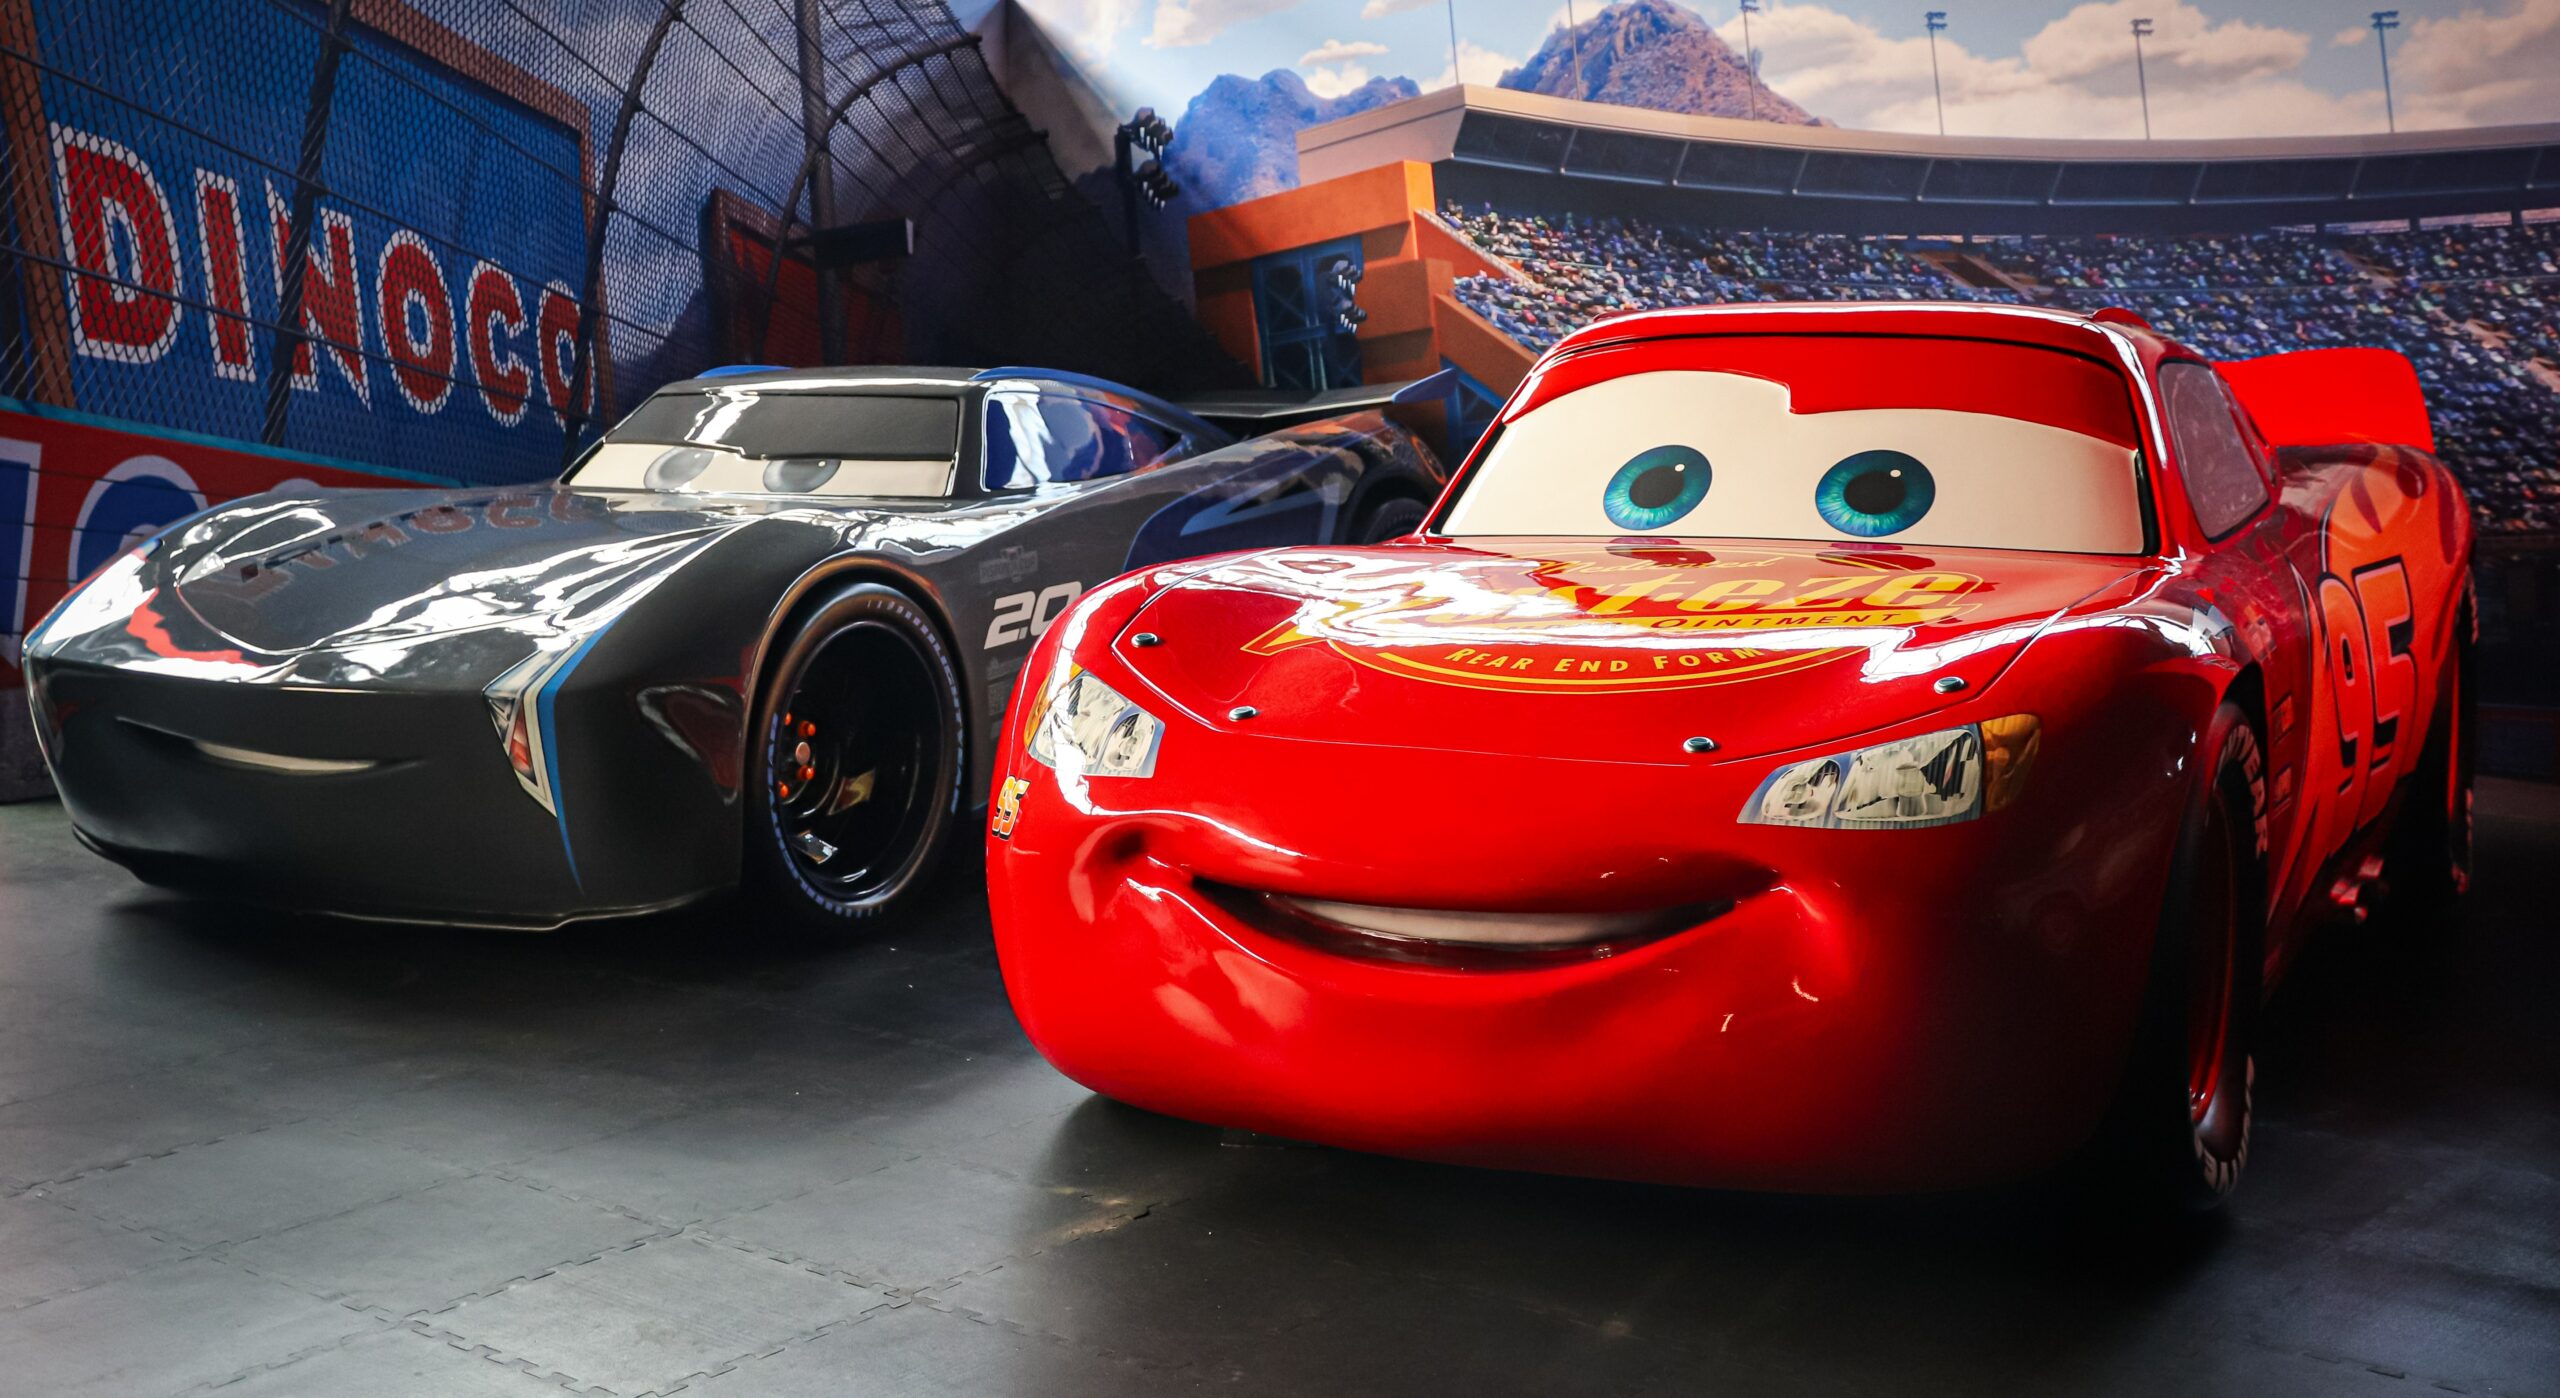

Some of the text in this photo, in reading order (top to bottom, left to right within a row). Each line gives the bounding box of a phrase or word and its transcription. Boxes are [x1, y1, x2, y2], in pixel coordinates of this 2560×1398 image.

[50, 120, 594, 437] DINOCO
[1650, 612, 1902, 630] OINTMENT
[1444, 648, 1535, 671] REAR
[1553, 658, 1629, 673] END
[2317, 555, 2419, 858] 95
[992, 775, 1031, 842] 95
